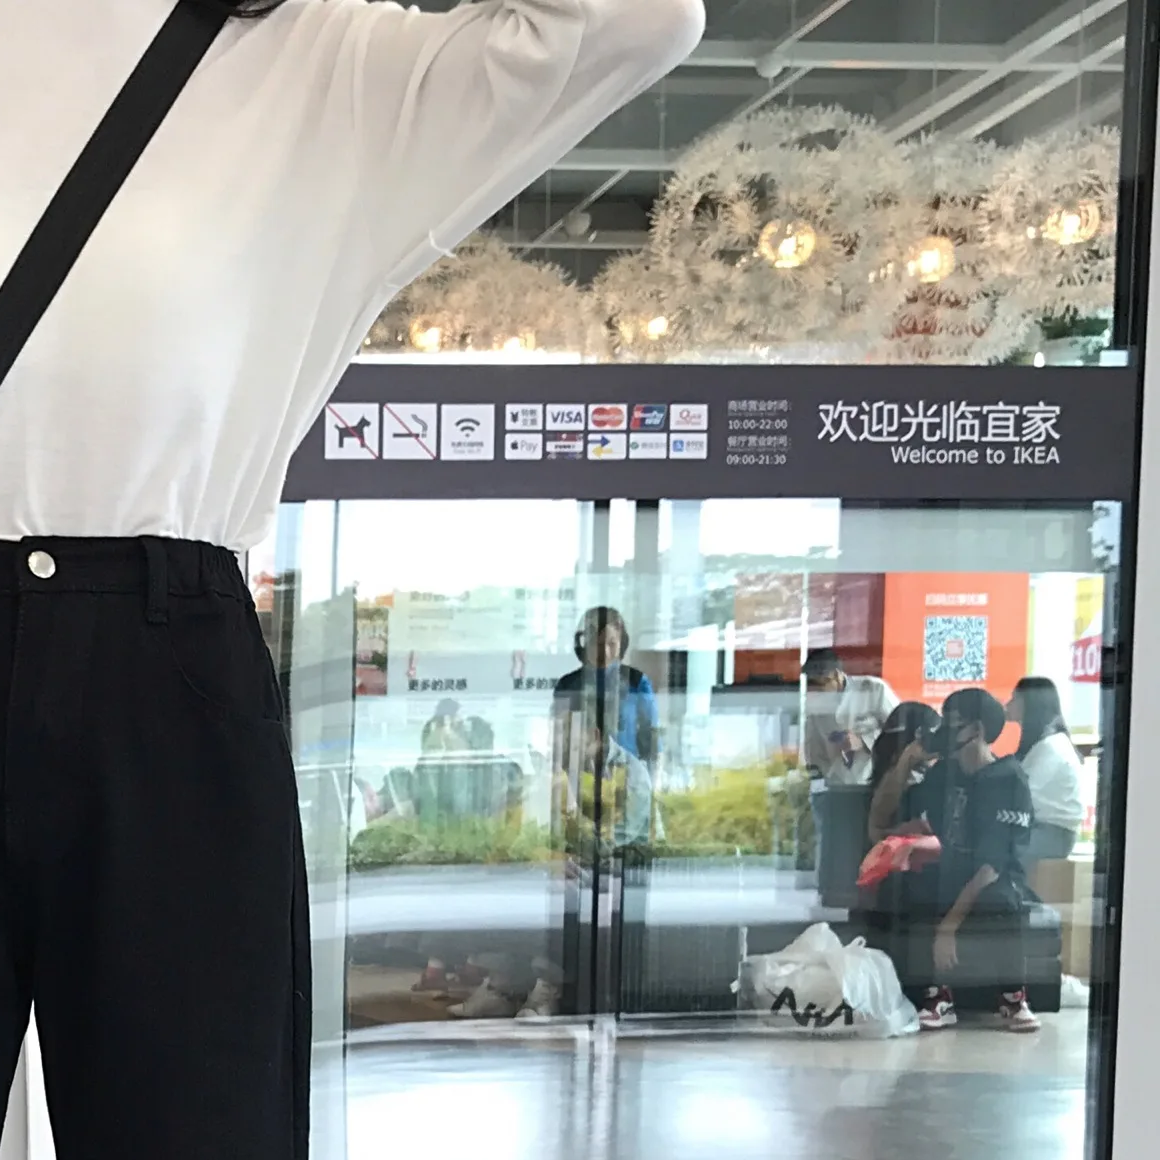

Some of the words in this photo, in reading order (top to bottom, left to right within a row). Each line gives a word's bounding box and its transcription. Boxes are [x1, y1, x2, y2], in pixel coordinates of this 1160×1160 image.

[551, 411, 583, 424] VISA
[817, 400, 1061, 443] 欢迎光临宜家
[728, 419, 788, 430] 10:00-22:00
[520, 440, 538, 453] Pay
[726, 454, 787, 465] 09:00-21:30
[891, 446, 979, 464] Welcome
[986, 448, 1006, 464] to
[1013, 447, 1060, 464] IKEA
